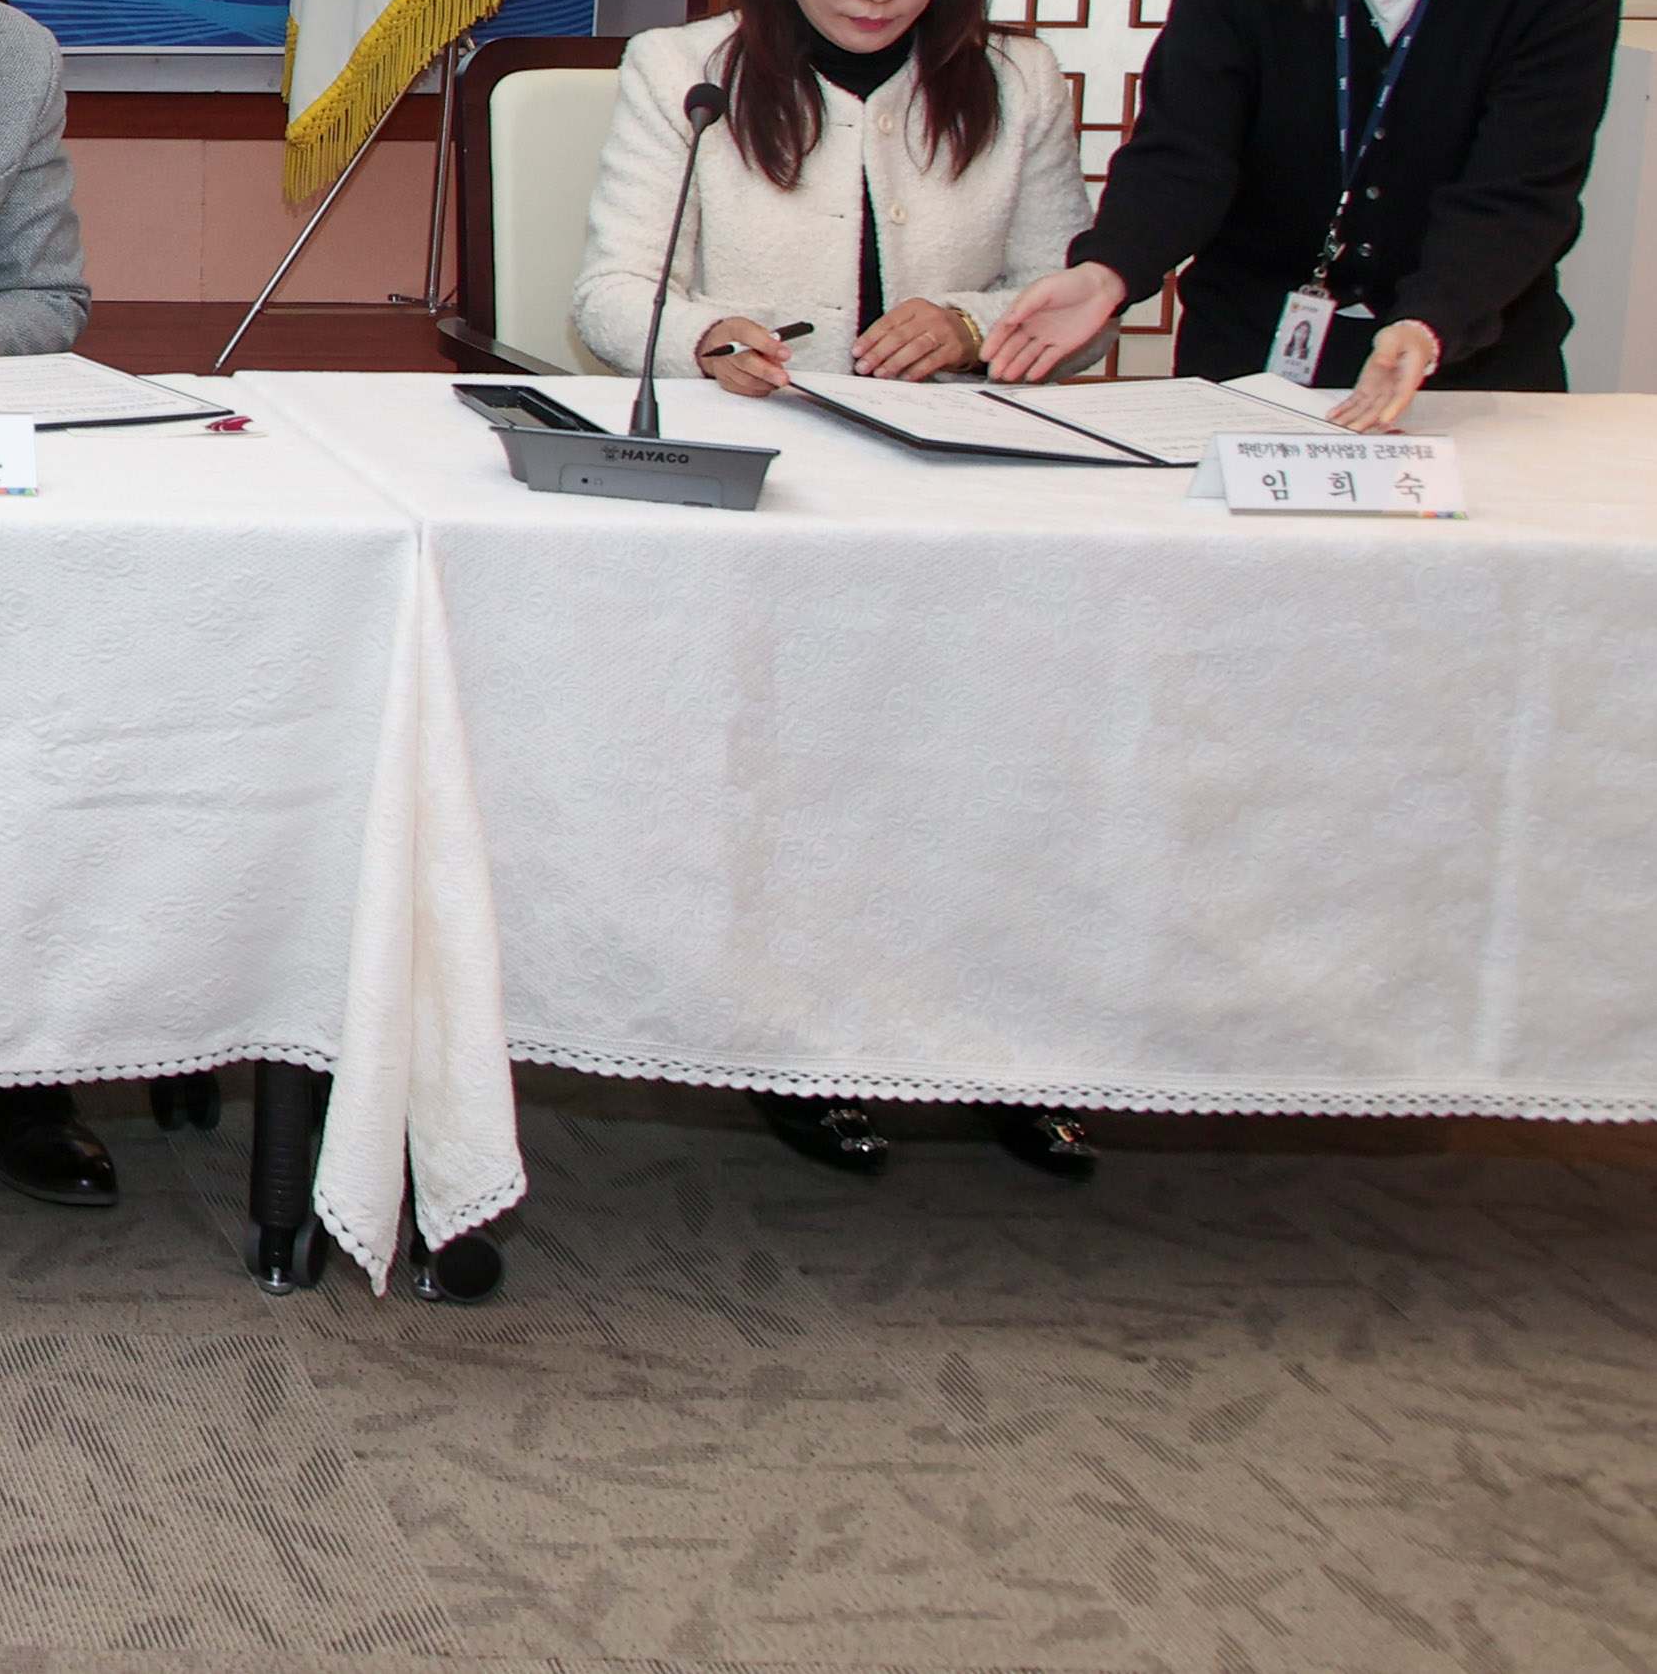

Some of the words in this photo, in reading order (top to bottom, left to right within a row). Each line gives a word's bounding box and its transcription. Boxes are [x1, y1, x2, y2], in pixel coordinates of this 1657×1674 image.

[620, 448, 690, 465] HAYACO
[1305, 442, 1368, 459] 참여사업장
[1372, 443, 1436, 460] 근로자대표
